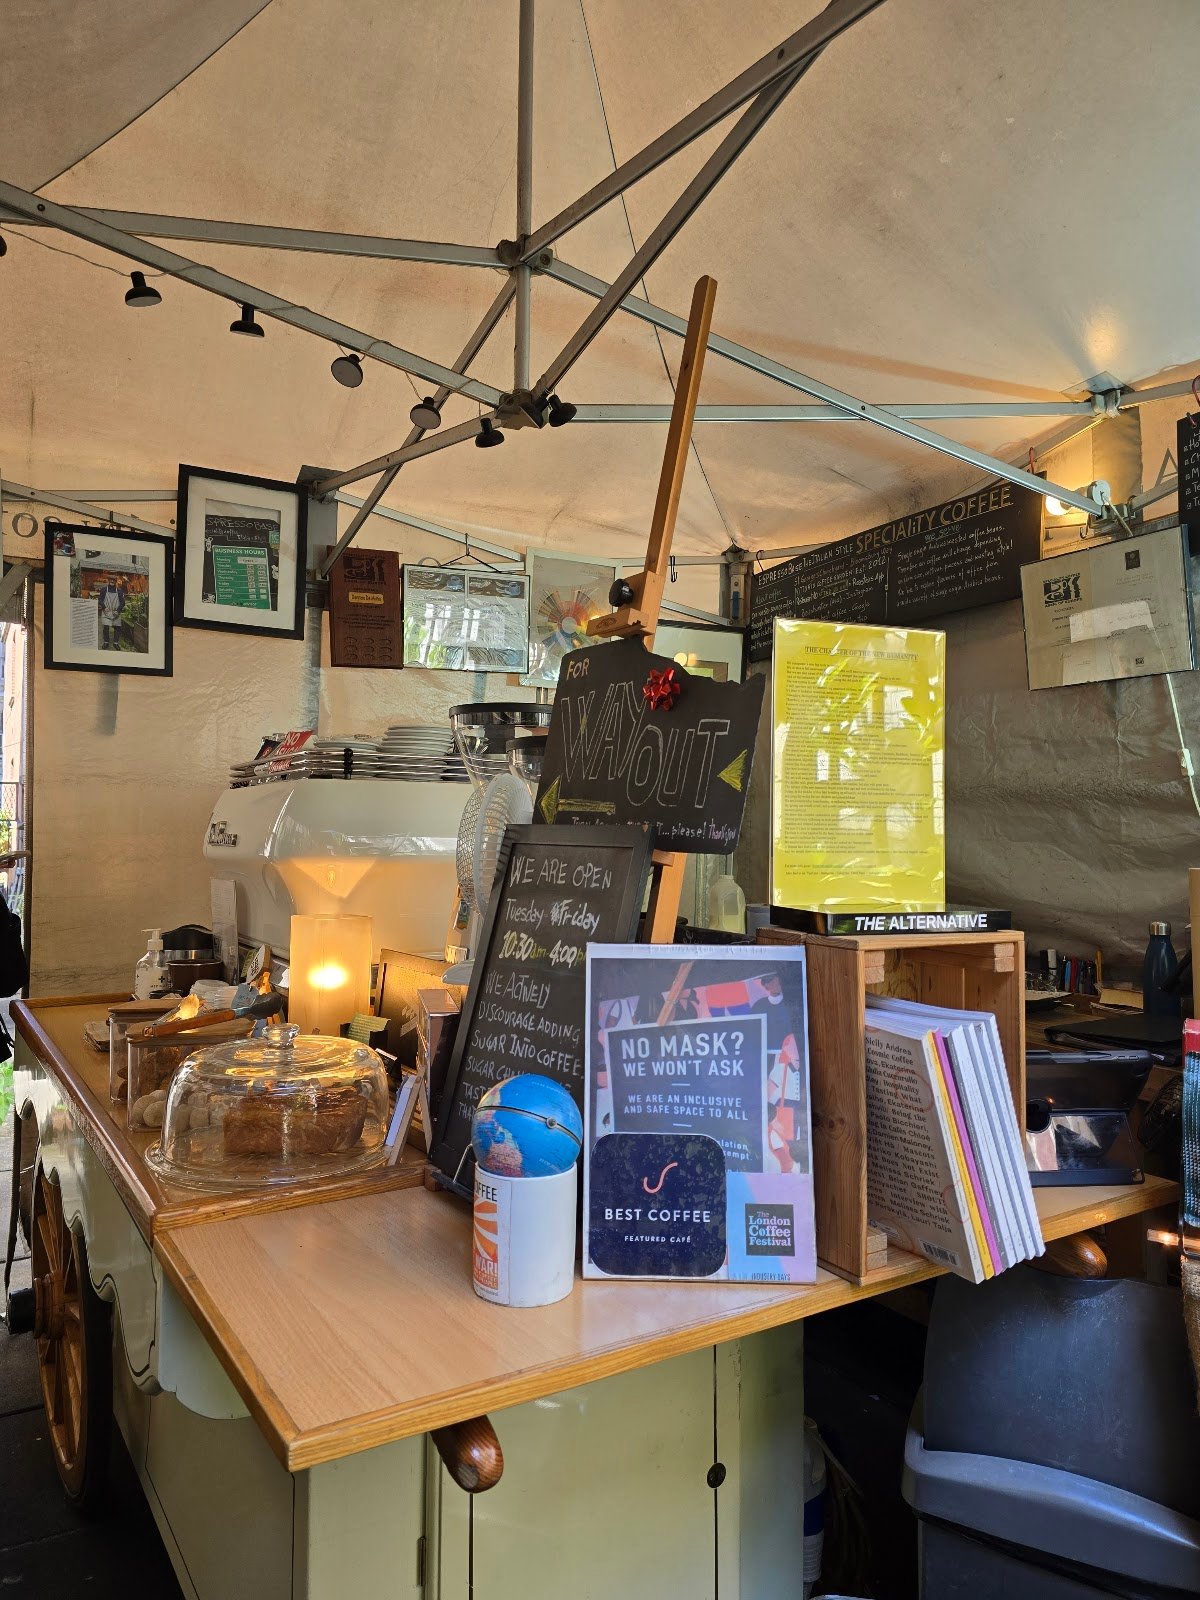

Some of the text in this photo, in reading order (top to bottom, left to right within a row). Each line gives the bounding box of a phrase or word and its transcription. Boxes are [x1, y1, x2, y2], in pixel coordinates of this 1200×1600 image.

[835, 542, 854, 556] STYLE
[940, 486, 1013, 525] COFFEE
[818, 647, 848, 656] CHAER
[566, 658, 590, 680] FOR
[285, 731, 301, 746] NO
[561, 679, 650, 782] WAY
[627, 719, 731, 808] OUT
[671, 821, 707, 840] please!
[510, 855, 612, 890] WE ARE OPEN
[505, 898, 545, 930] Tuesday
[855, 914, 988, 931] THE ALTERNATIVE
[485, 970, 502, 995] WE
[478, 1001, 581, 1044] DISCOURAGE ADDING
[471, 1030, 506, 1055] SUGAR
[509, 1033, 536, 1059] INTO
[621, 1031, 745, 1060] NO MASK?
[465, 1056, 495, 1081] SUGAR
[623, 1060, 745, 1077] WE WON'T ASK
[628, 1094, 742, 1108] WE ARE AN INCLUSIVE
[623, 1105, 749, 1121] AND SAFE SPACE TO ALL
[605, 1208, 711, 1223] BEST COFFEE
[748, 1215, 791, 1226] London
[624, 1235, 691, 1244] FEATURED CAFÉ
[748, 1225, 791, 1237] Coffee
[748, 1236, 792, 1247] Festival
